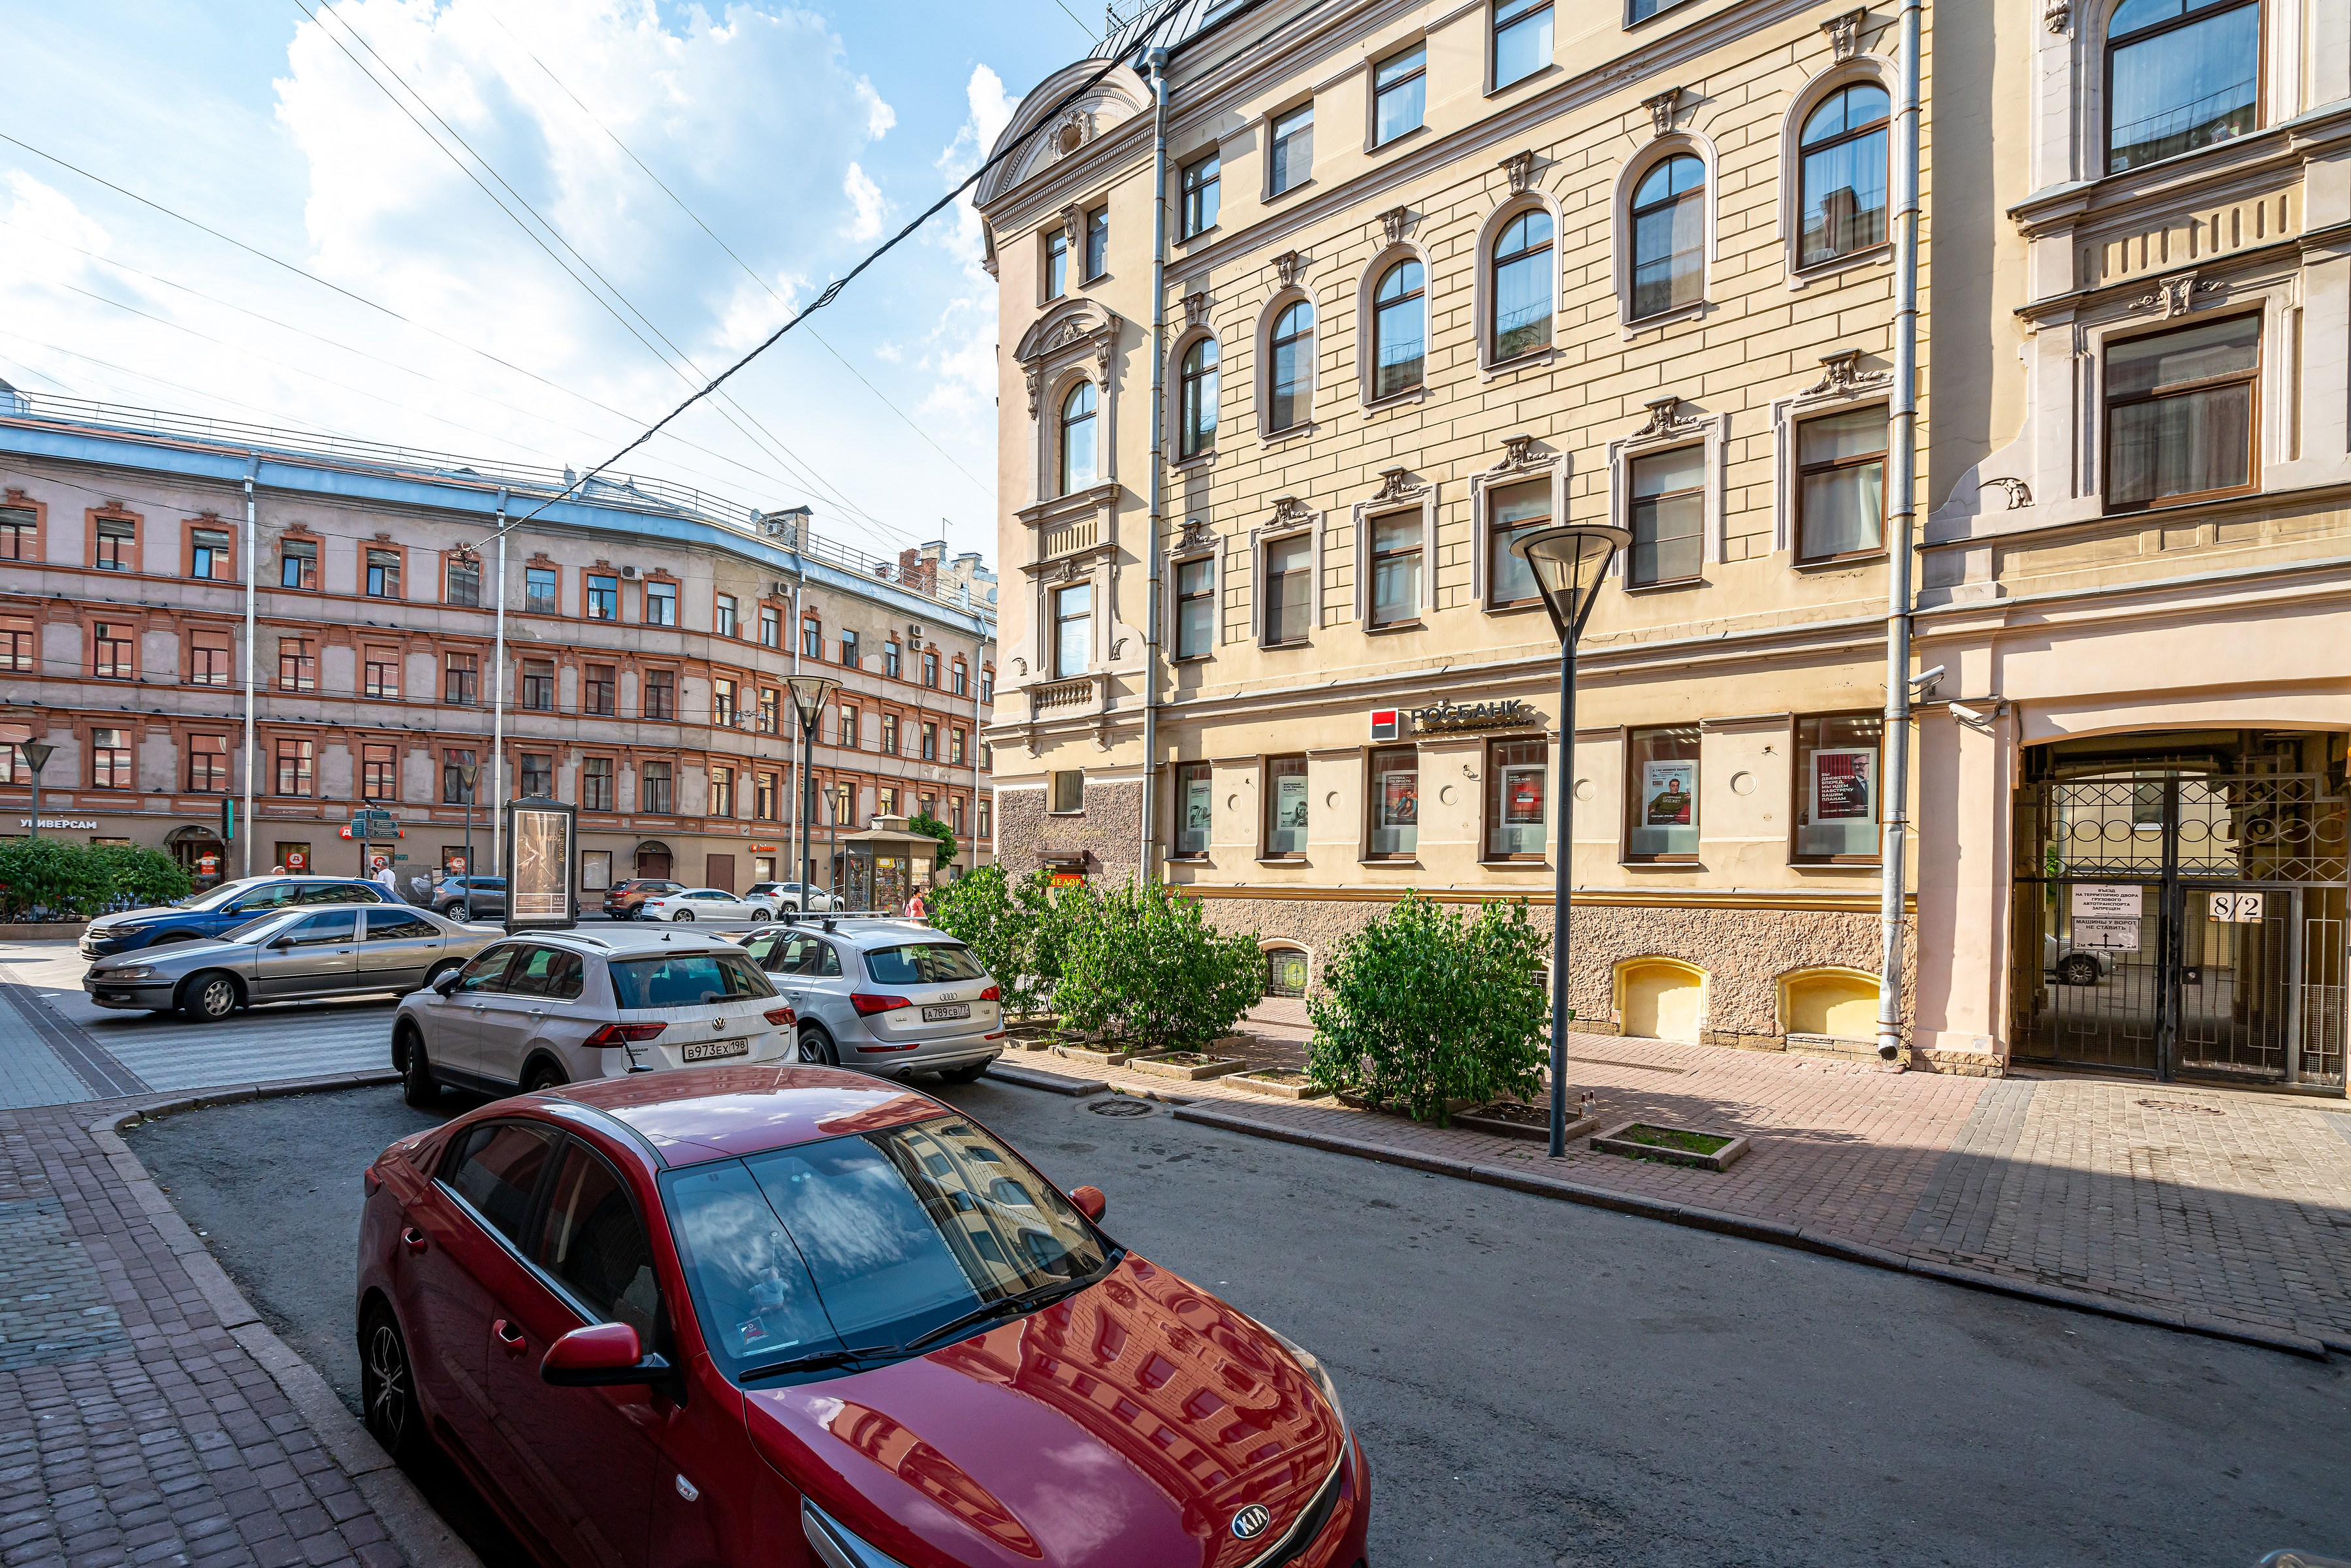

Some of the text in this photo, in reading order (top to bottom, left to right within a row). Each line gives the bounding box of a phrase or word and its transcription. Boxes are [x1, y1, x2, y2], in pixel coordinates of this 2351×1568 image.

[1411, 699, 1522, 723] РОСБАНК
[2215, 896, 2258, 920] 8/2
[731, 1040, 744, 1049] 198
[1237, 1508, 1267, 1535] KIA
